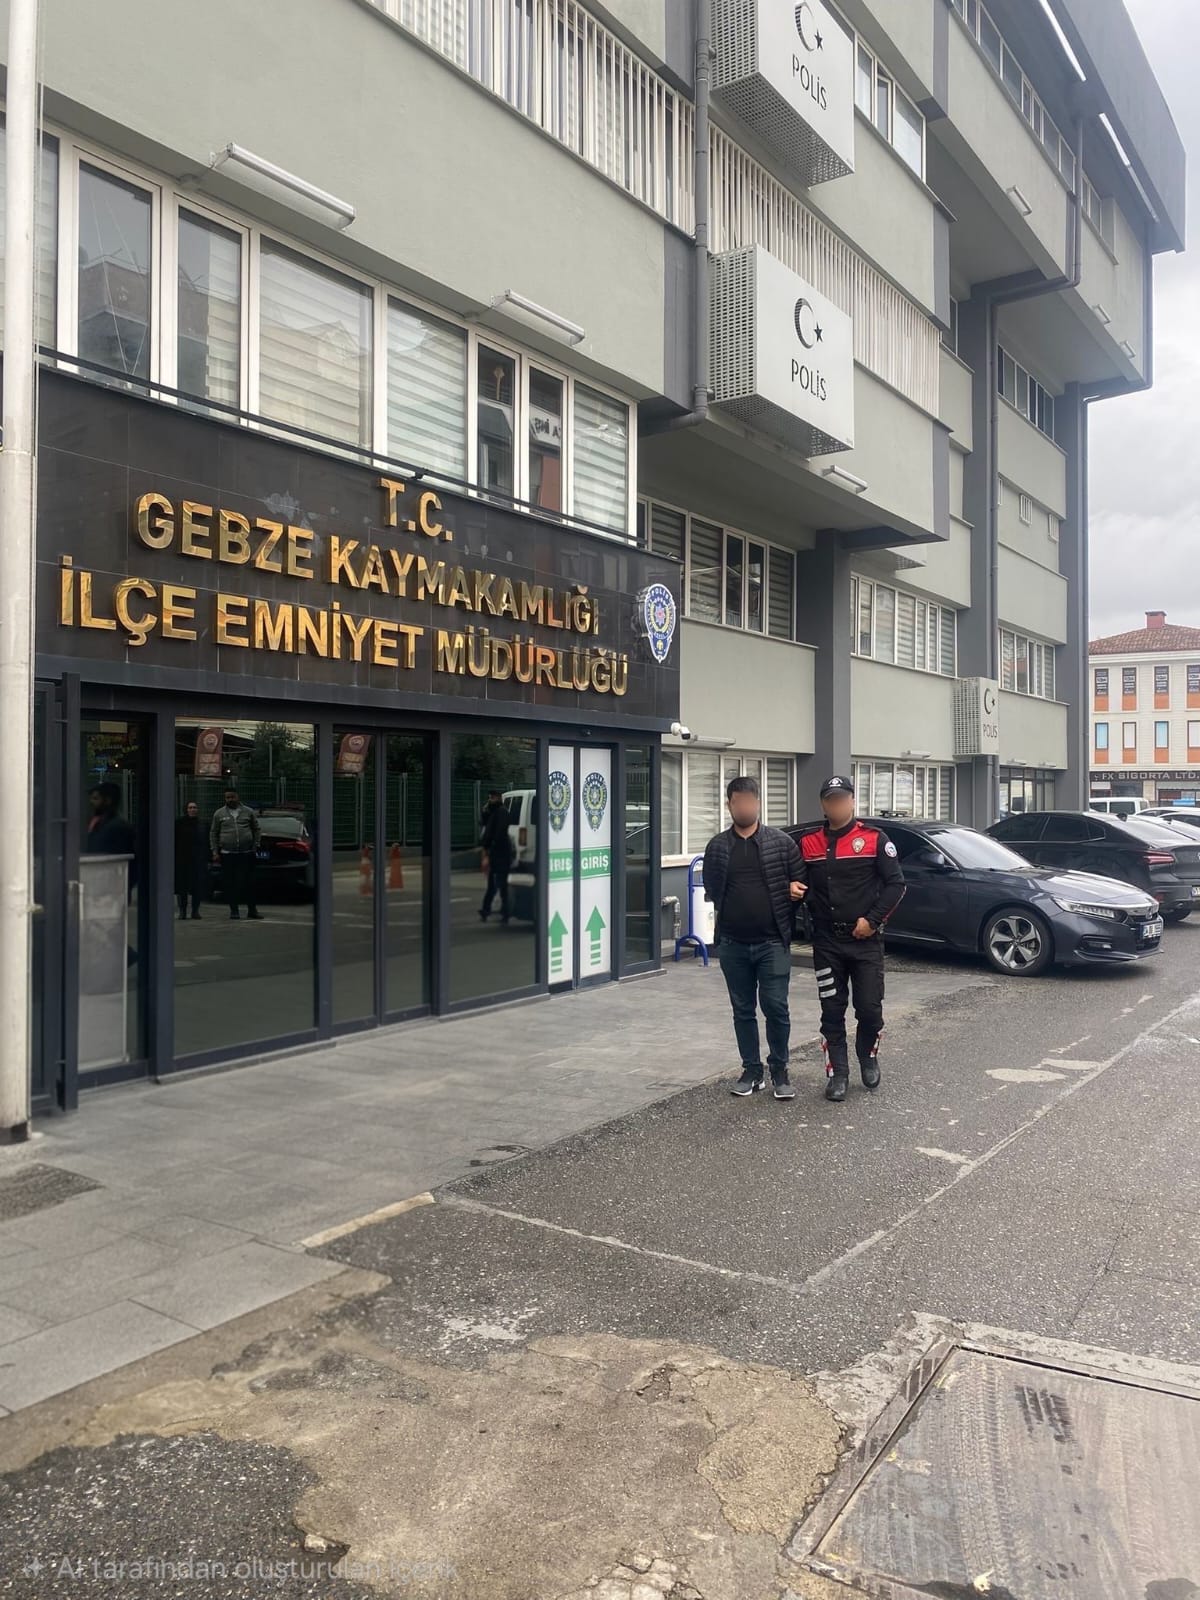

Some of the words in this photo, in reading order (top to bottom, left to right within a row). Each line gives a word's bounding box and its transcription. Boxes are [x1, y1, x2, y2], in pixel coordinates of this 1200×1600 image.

[792, 53, 827, 110] POLİS
[791, 358, 827, 401] POLİS
[136, 492, 314, 579] GEBZE
[379, 477, 453, 541] T.C.
[59, 554, 197, 647] İLÇE
[215, 592, 424, 669] EMNİYET
[436, 624, 628, 696] MÜDÜRLÜĞÜ
[1175, 771, 1200, 780] LTD.
[580, 852, 609, 871] GİRİŞ
